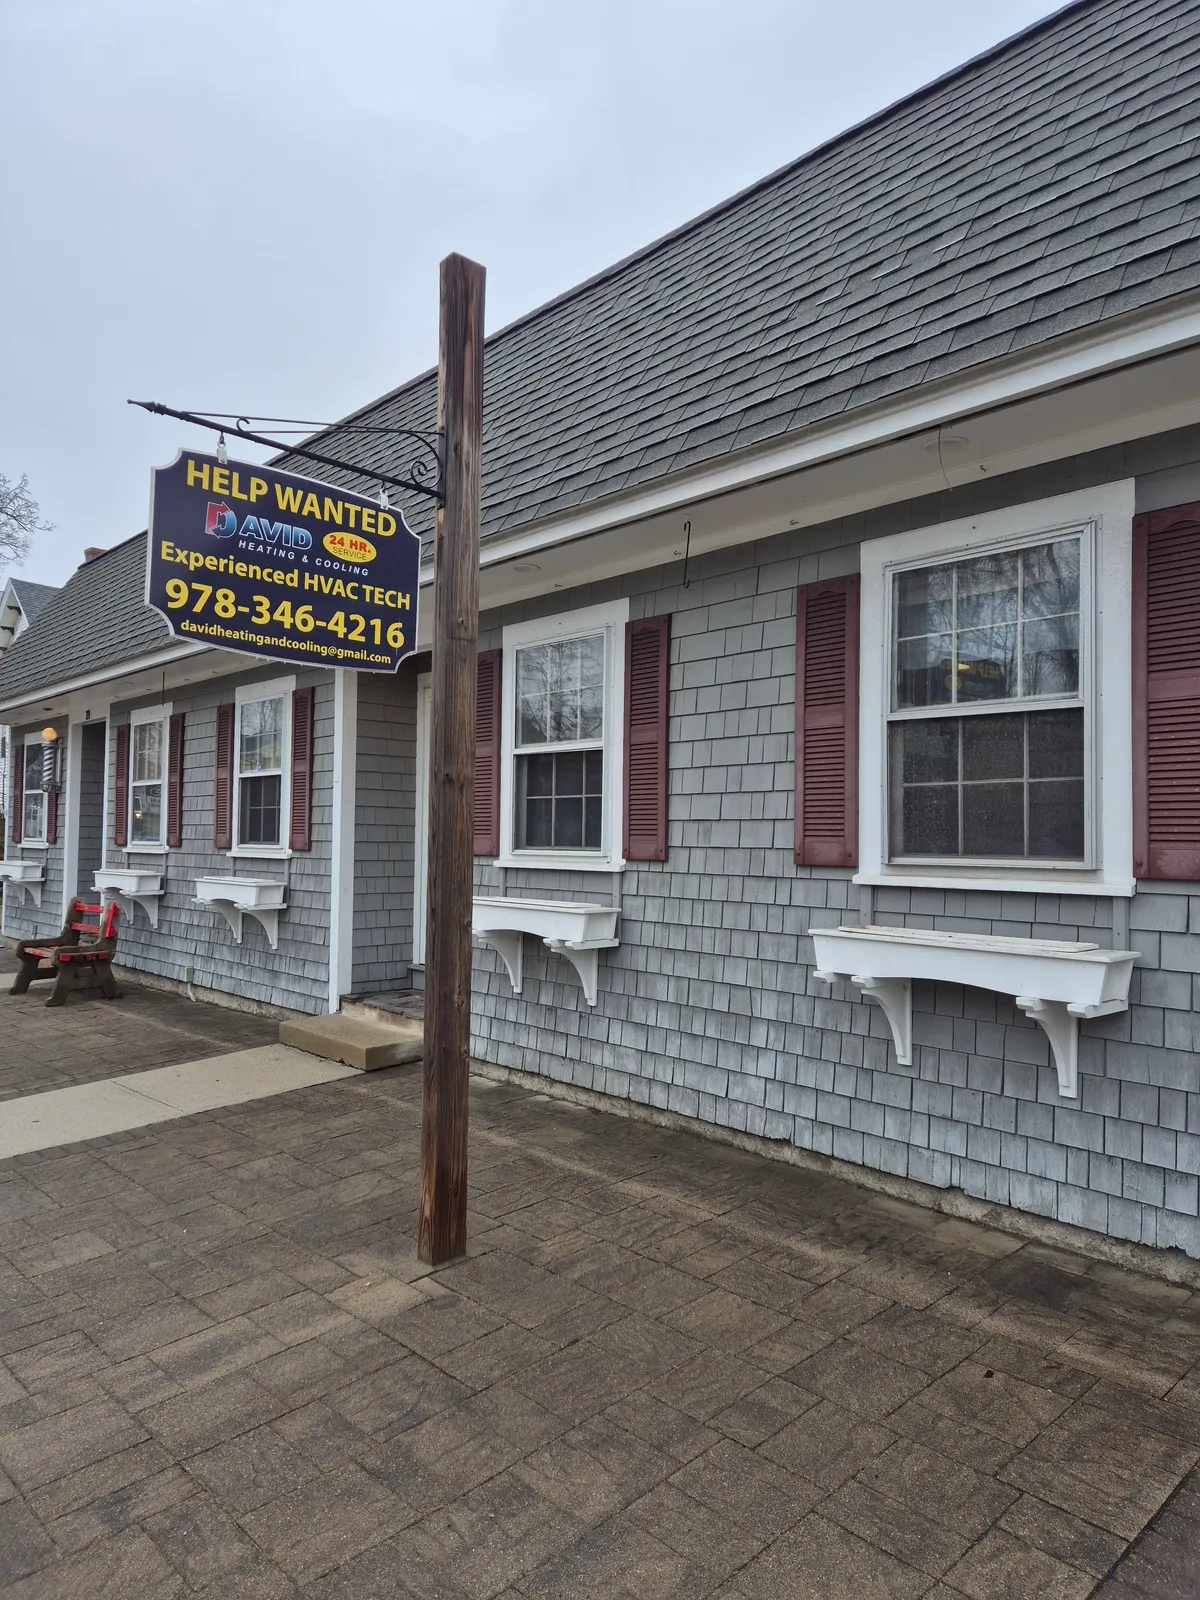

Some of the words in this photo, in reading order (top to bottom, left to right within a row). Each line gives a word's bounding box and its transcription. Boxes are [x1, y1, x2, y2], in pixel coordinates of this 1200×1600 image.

[187, 459, 268, 502] HELP
[275, 483, 397, 537] WANTED
[205, 501, 312, 550] DAVID
[329, 534, 345, 547] 24
[349, 539, 371, 554] HR.
[161, 540, 299, 588] Experienced
[304, 572, 359, 600] HVAC
[362, 584, 410, 611] TECH
[238, 540, 295, 560] HEATING
[302, 554, 309, 563] &
[315, 558, 369, 576] COOLING
[332, 546, 367, 560] SERVICE
[165, 578, 405, 649] 978-346-4216
[180, 620, 391, 664] davidheatingandcooling@gmail.com
